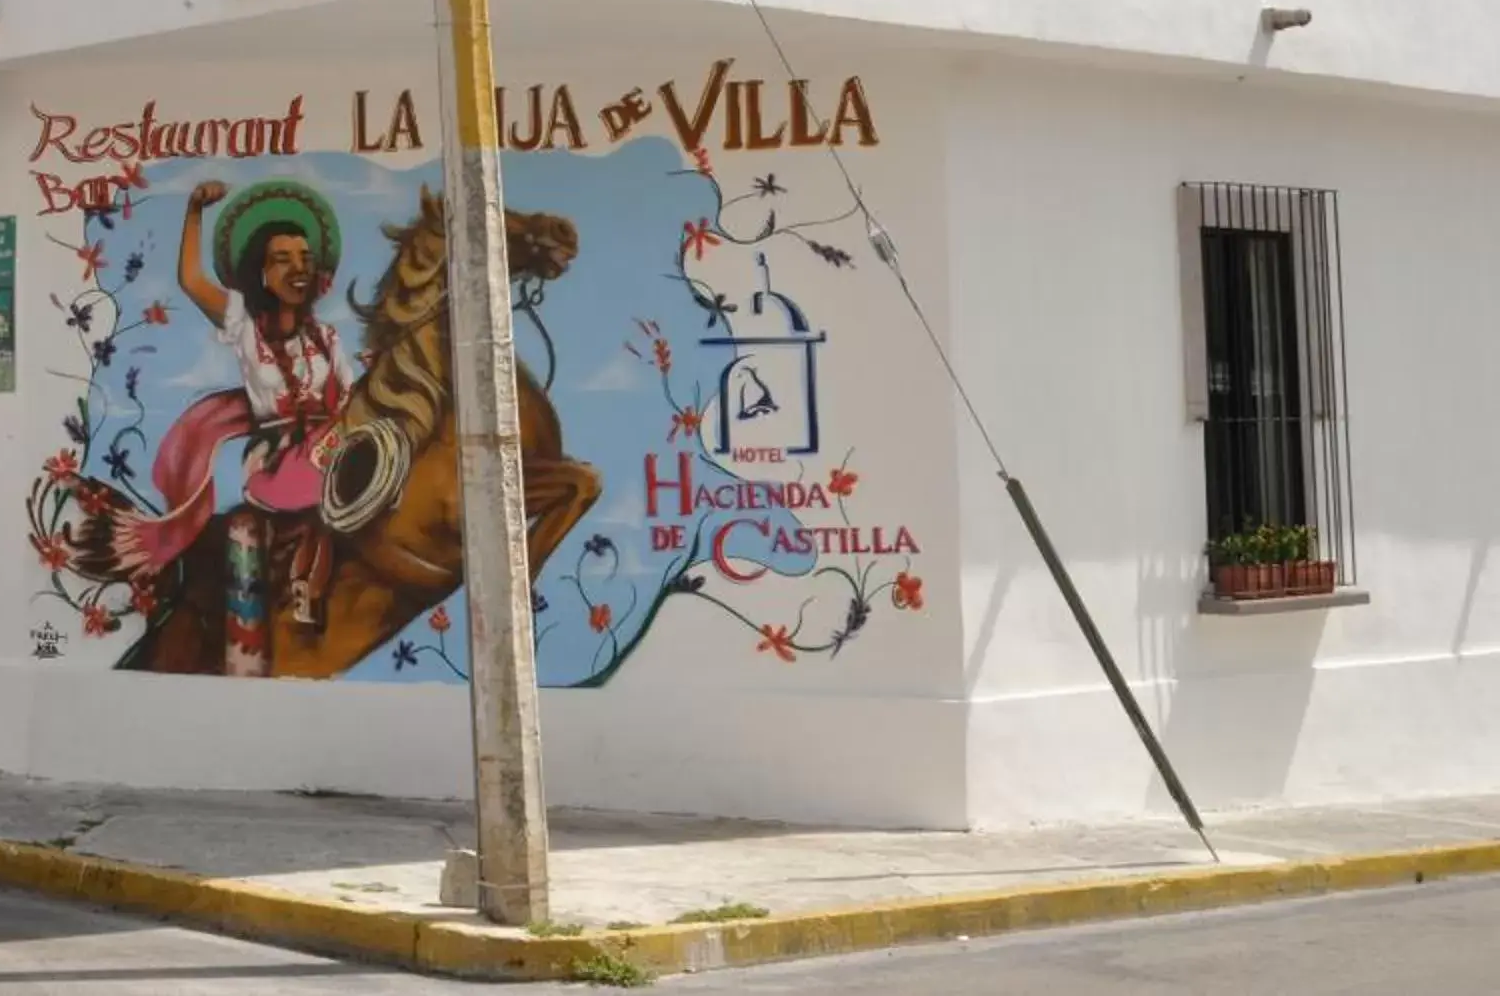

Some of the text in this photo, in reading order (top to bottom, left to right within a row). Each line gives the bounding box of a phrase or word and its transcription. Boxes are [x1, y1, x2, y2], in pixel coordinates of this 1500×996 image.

[29, 94, 304, 162] Restaurant
[351, 57, 880, 154] LA IJA DE VILLA
[29, 170, 129, 216] Bar
[644, 451, 830, 518] HACIENDA
[732, 447, 786, 463] HOTEL
[650, 517, 921, 583] DE CASTILLA
